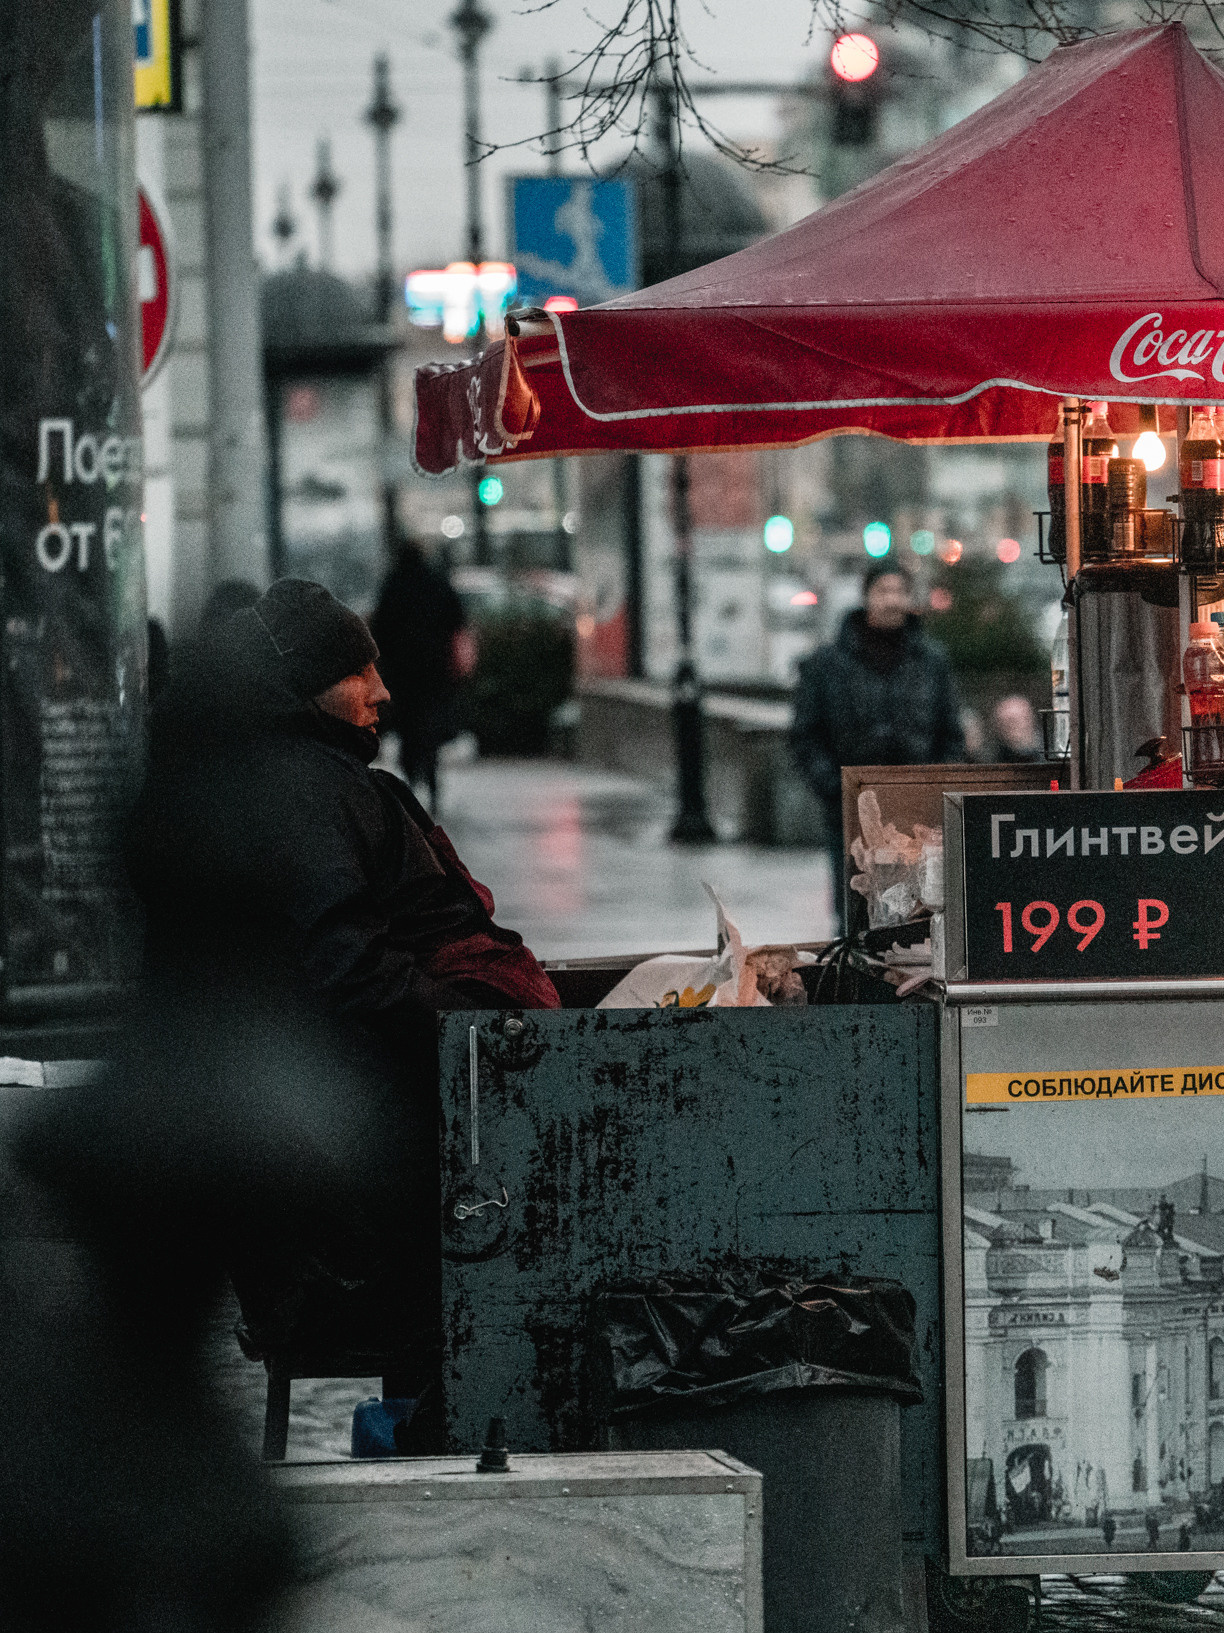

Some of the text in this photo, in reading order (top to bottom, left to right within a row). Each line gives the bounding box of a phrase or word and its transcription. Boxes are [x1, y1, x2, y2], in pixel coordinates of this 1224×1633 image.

[36, 522, 96, 573] от
[995, 900, 1106, 953] 199
[973, 1016, 987, 1024] 093
[1008, 1071, 1174, 1098] СОБЛЮДАЙТЕ
